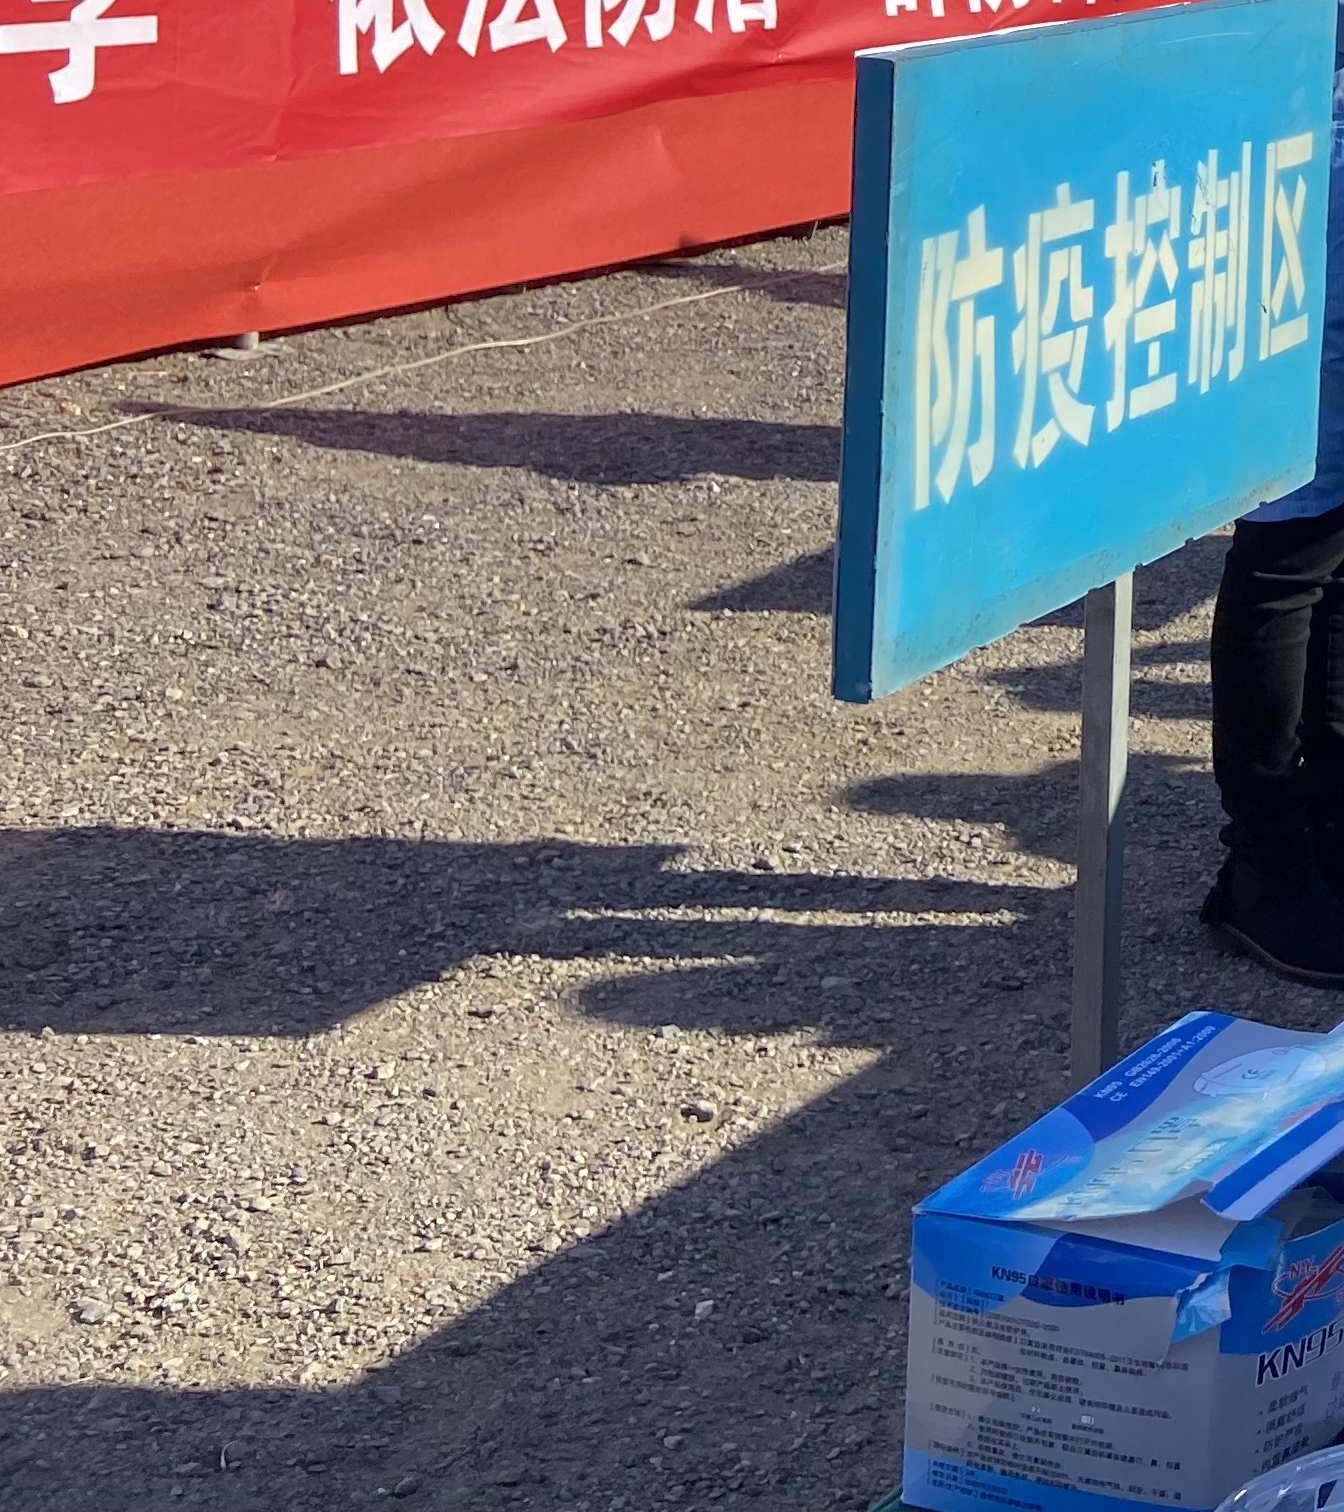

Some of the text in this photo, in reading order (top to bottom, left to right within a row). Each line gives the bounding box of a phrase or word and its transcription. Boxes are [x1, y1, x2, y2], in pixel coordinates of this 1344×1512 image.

[914, 132, 1314, 512] 防疫控制区
